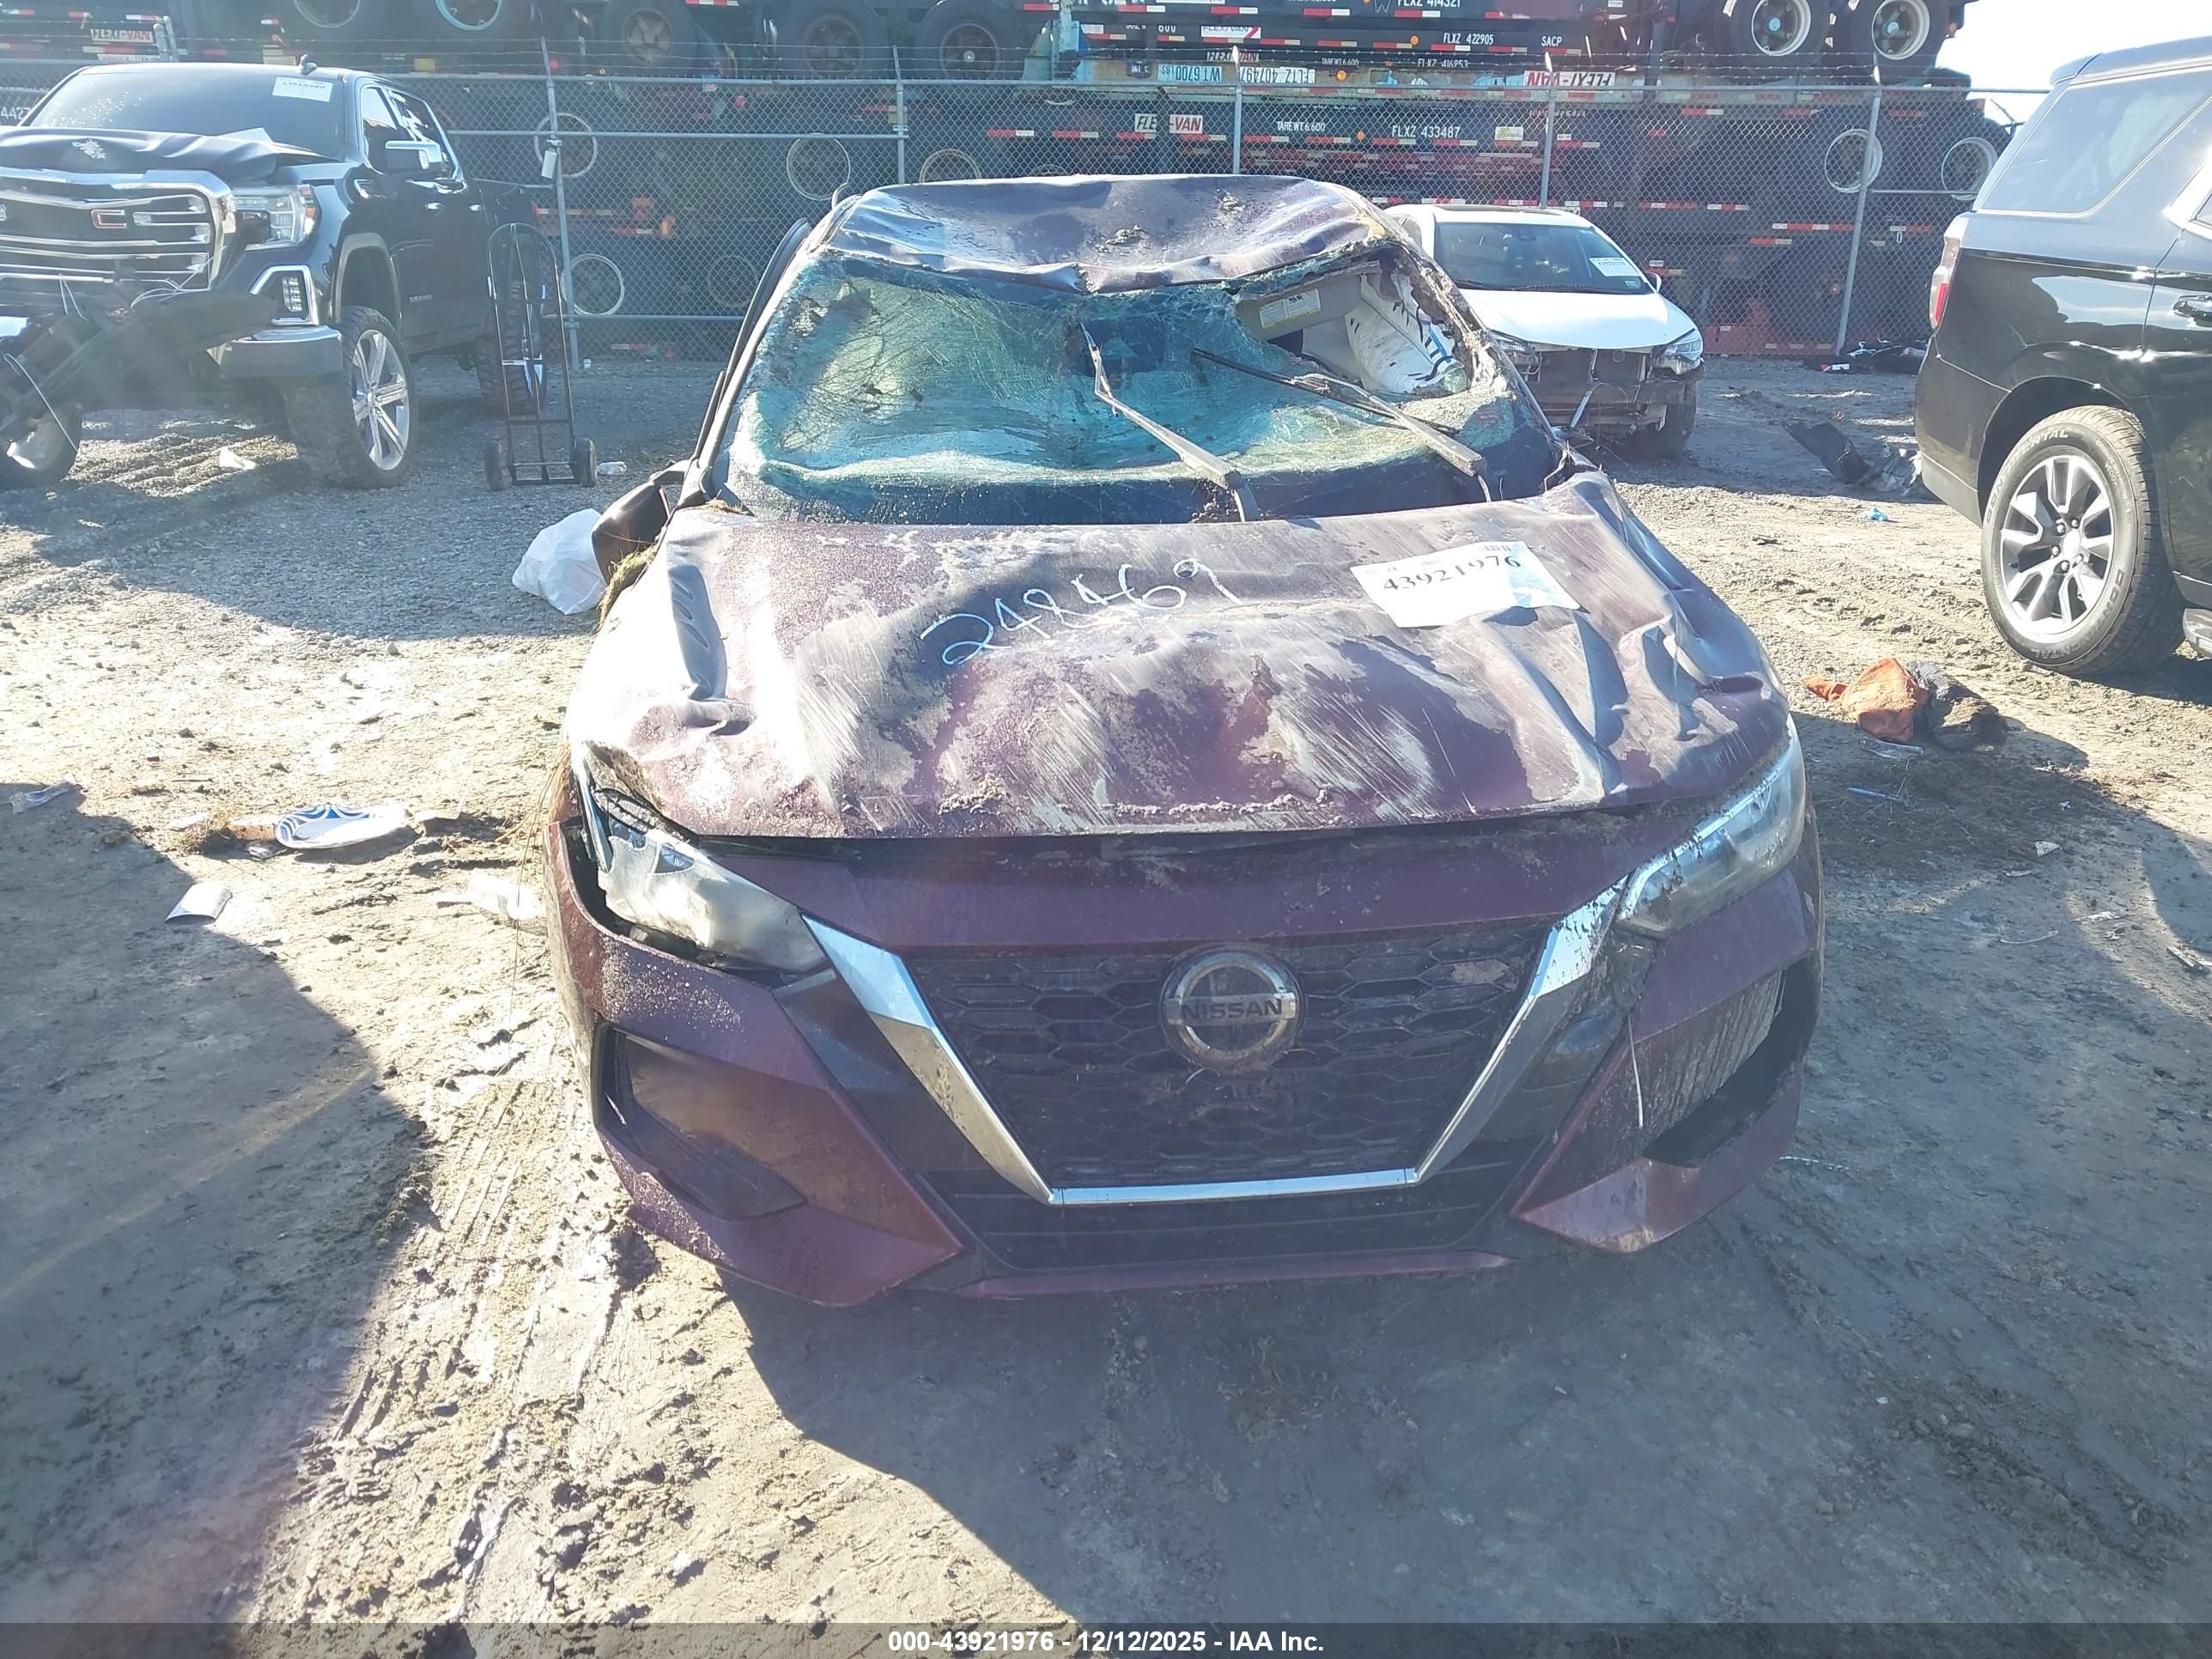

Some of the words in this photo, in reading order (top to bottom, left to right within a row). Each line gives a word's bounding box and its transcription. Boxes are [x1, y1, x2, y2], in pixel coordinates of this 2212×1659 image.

[1443, 33, 1461, 44] FLXZ
[1466, 33, 1494, 45] 422905
[1540, 35, 1563, 46] SACP
[1392, 125, 1417, 137] FLXZ
[1420, 125, 1460, 138] 433487
[1382, 555, 1522, 591] 43921976
[1180, 997, 1283, 1020] NISSAN
